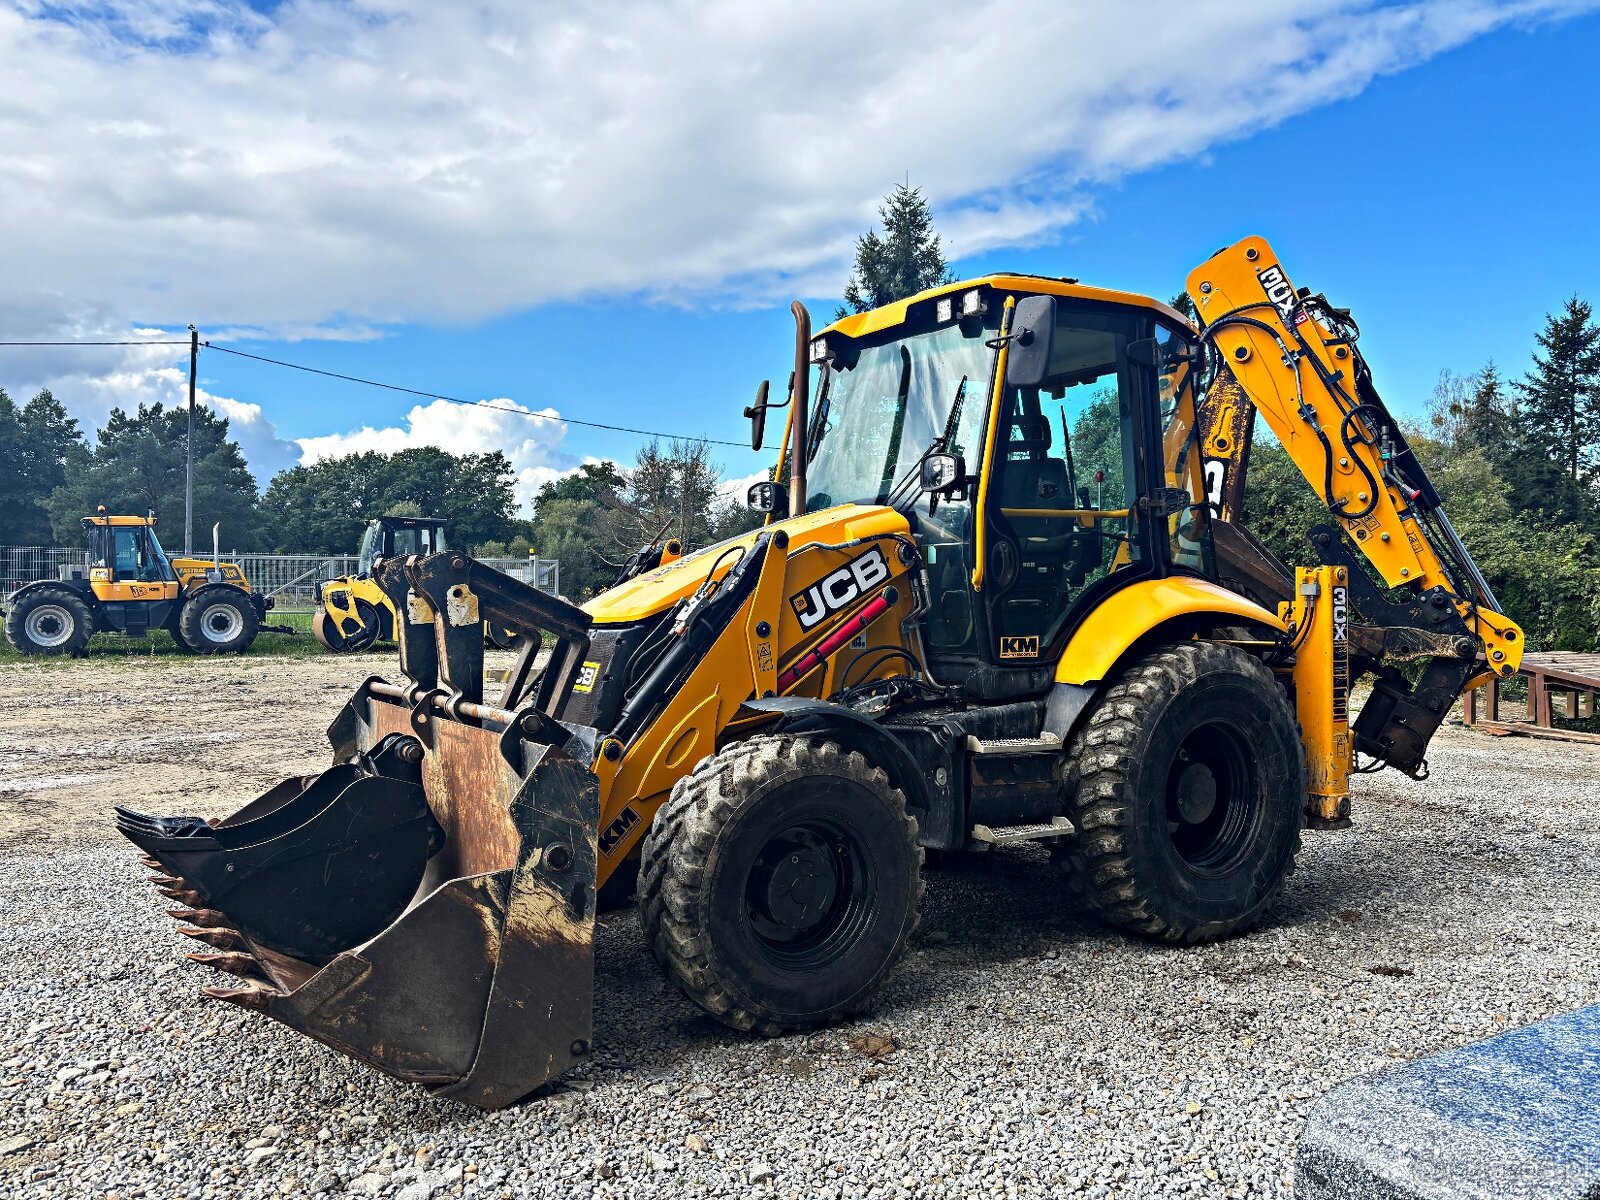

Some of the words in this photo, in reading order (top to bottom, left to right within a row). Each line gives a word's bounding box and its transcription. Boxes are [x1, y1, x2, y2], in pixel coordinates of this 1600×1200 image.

[800, 550, 887, 627] JCB
[1333, 587, 1347, 641] 3CX
[1003, 638, 1037, 652] KM
[598, 807, 637, 854] KM
